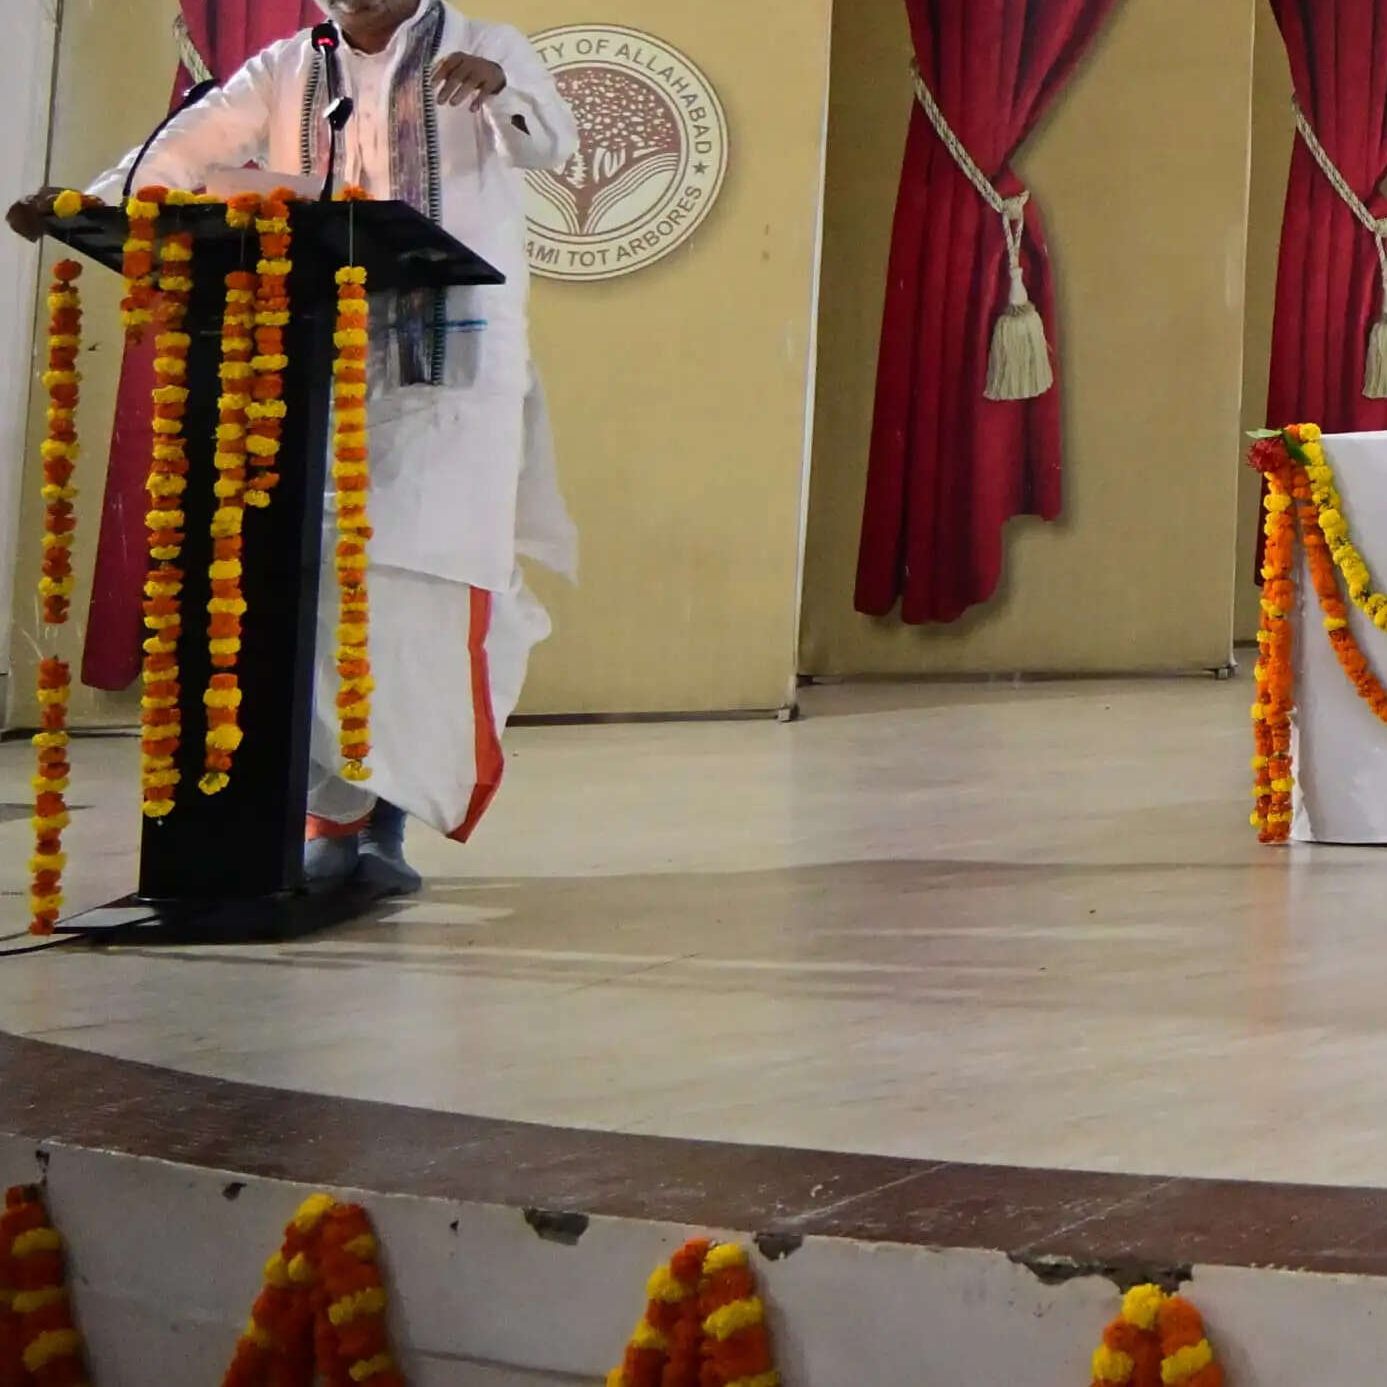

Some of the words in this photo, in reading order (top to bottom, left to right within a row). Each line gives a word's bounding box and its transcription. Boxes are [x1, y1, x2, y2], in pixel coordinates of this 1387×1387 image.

[575, 38, 610, 55] OF
[615, 42, 713, 154] ALLAHABAD
[526, 241, 560, 265] AMI
[567, 248, 611, 266] TOT
[615, 185, 702, 262] ARBORES
